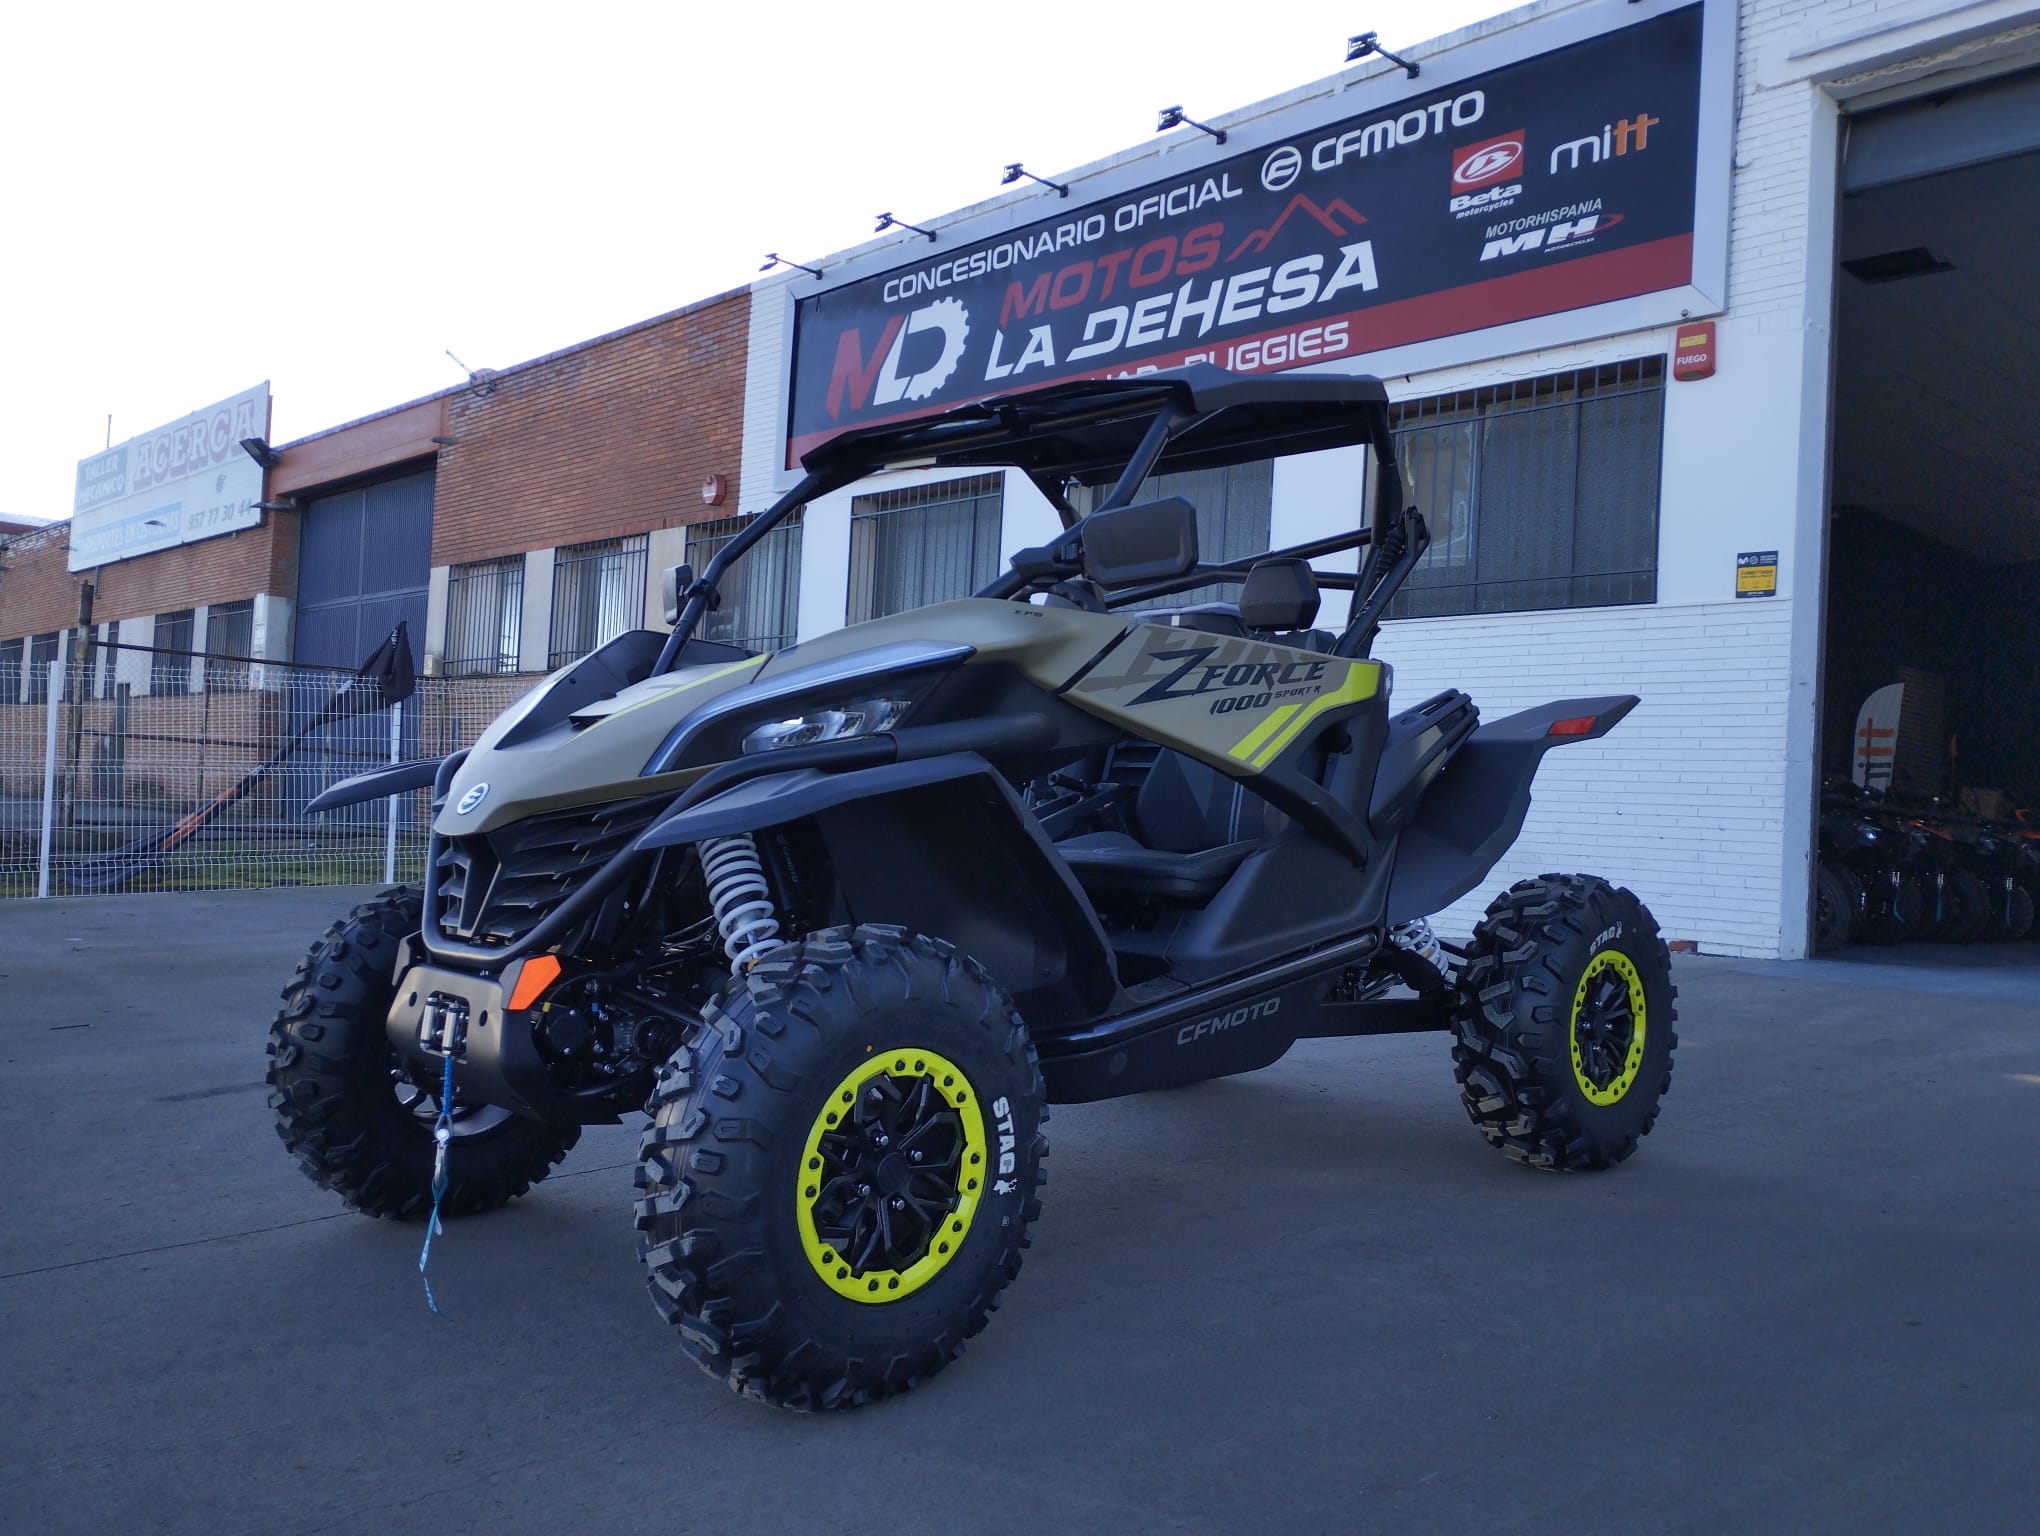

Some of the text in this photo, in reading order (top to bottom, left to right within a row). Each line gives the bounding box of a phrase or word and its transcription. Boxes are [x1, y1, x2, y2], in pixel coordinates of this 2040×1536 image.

[1550, 113, 1659, 175] mitt
[884, 90, 1485, 303] CONCESIONARIO OFICIAL CFMOTO
[1450, 184, 1522, 213] Beta
[1455, 198, 1515, 220] motorcycles
[1479, 214, 1600, 262] MH
[1485, 197, 1602, 239] MOTORHISPANIA
[1544, 237, 1595, 254] MOTORCYCLES
[999, 221, 1225, 329] MOTOS
[984, 240, 1379, 382] LA DEHESA
[1677, 353, 1708, 365] FUEGO
[133, 399, 256, 491] ACERCA
[85, 453, 119, 481] TALLER
[207, 507, 220, 525] 77
[222, 503, 235, 521] 30
[1209, 685, 1322, 715] 1000 SPORT R
[1589, 926, 1616, 956] STAG
[1177, 997, 1281, 1046] CFMOTO
[993, 1096, 1016, 1175] STAG
